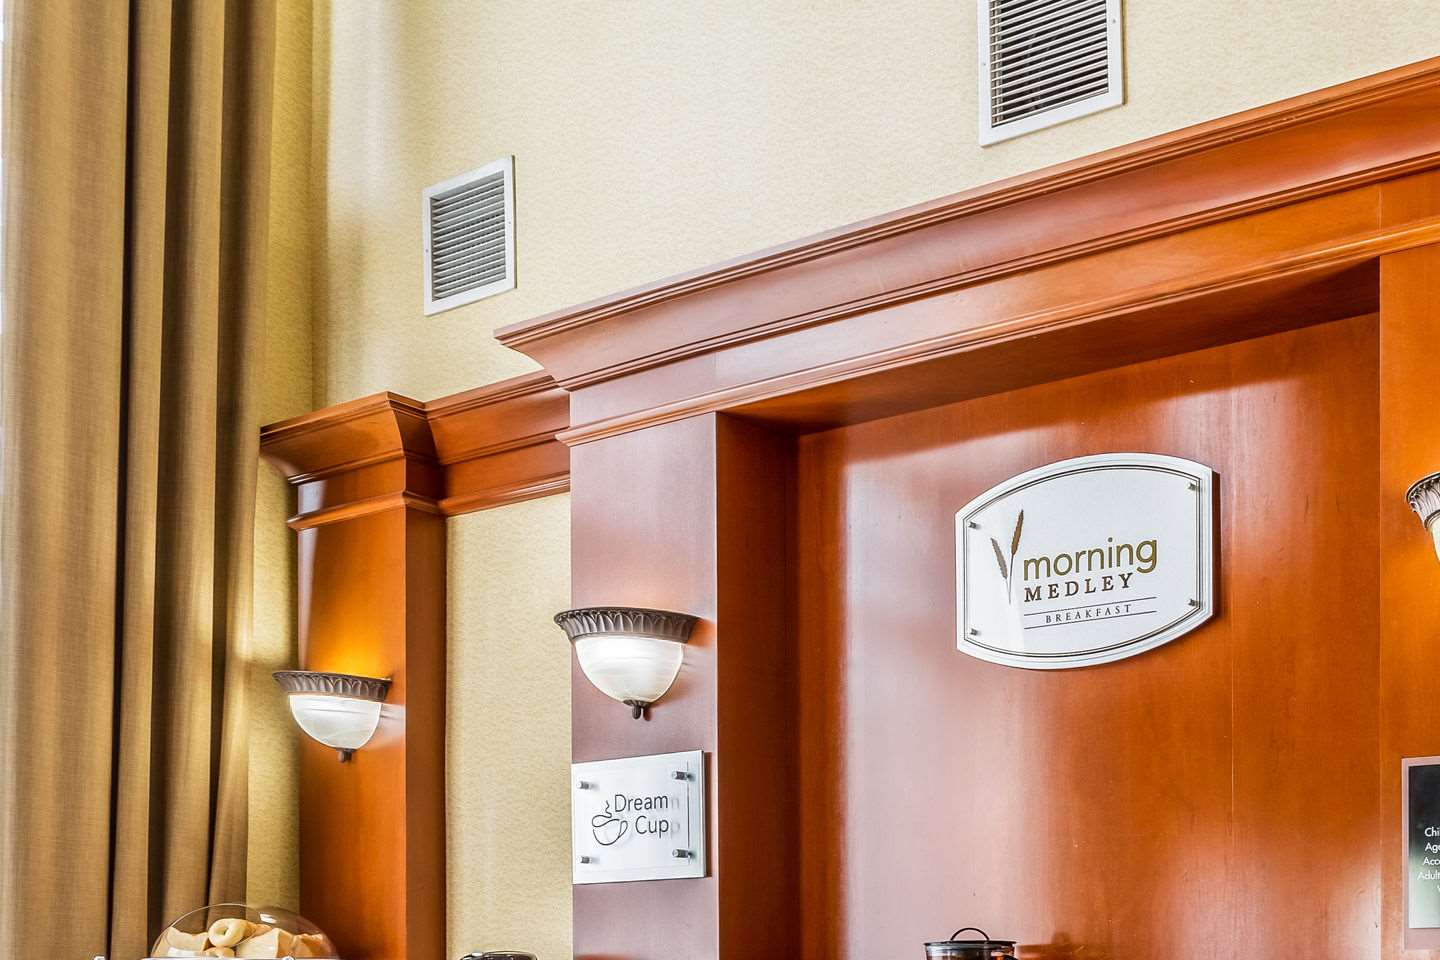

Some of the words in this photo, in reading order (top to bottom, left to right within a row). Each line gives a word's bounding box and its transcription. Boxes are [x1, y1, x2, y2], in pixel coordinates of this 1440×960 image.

[1023, 537, 1158, 581] morning
[1024, 573, 1133, 603] MEDLEY
[1045, 604, 1132, 624] BREAKFAST
[614, 794, 669, 812] Dream
[635, 815, 669, 839] Cup
[1417, 870, 1440, 880] Adult
